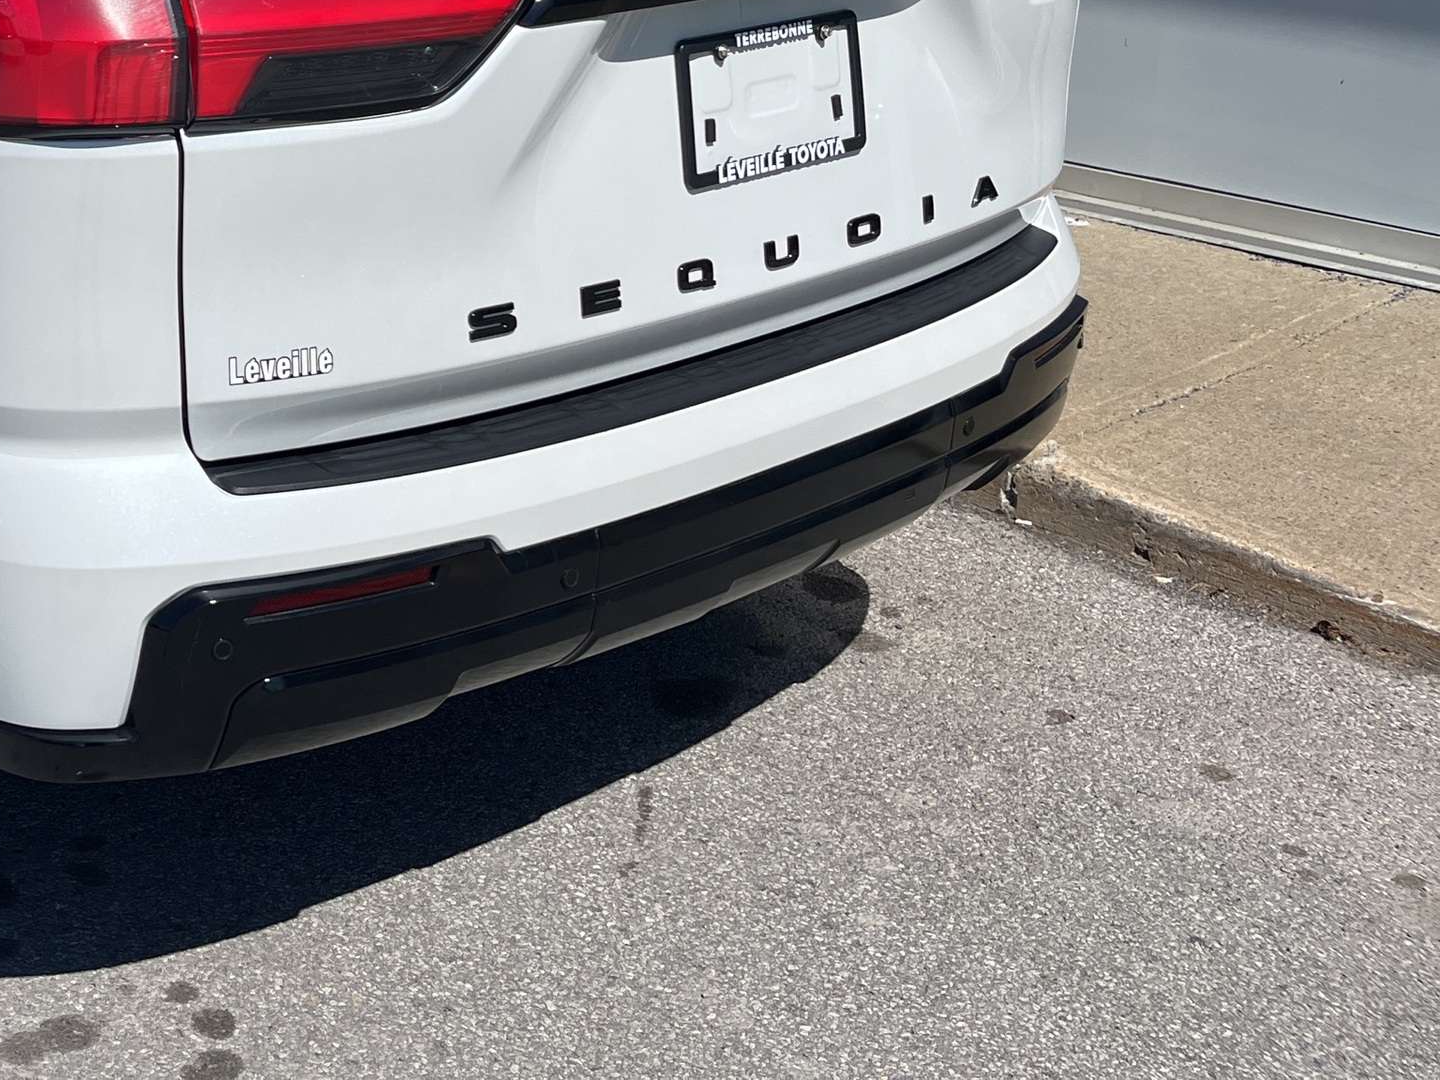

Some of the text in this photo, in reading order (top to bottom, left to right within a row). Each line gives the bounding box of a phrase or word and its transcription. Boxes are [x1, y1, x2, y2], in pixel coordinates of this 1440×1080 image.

[734, 19, 814, 48] TERREBONNE
[717, 137, 846, 184] LÉVEILLÉ TOYOTA
[467, 175, 999, 342] SEQUOIA
[228, 346, 334, 386] Léveillé
